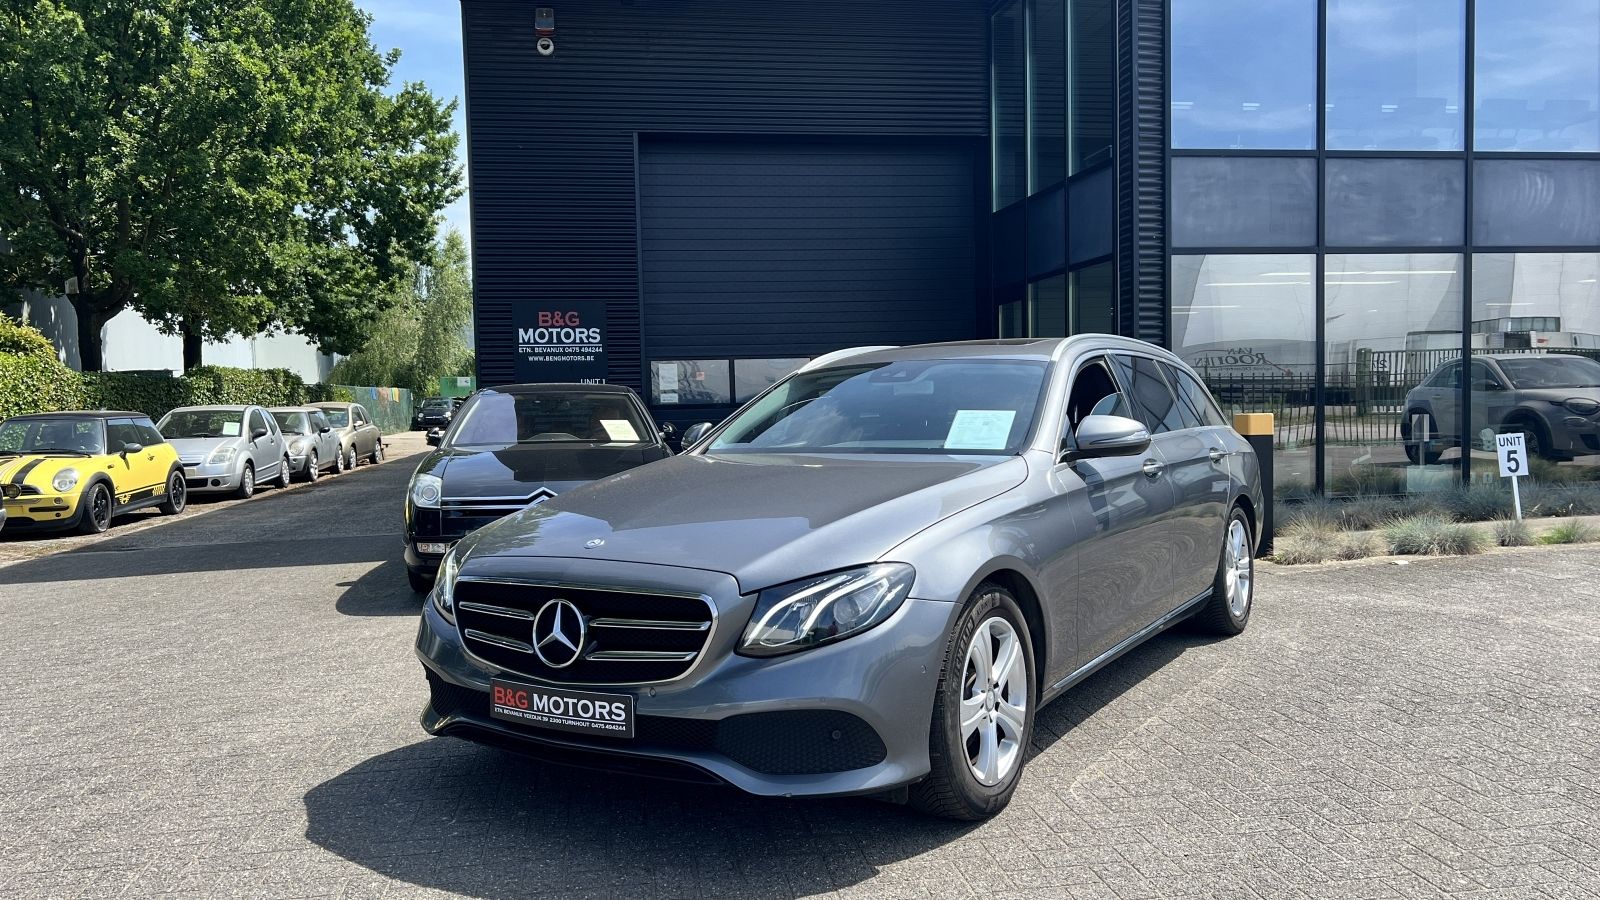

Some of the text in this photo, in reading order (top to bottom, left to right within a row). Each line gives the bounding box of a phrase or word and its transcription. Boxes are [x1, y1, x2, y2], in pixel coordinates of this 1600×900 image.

[538, 311, 580, 327] B&G
[518, 327, 601, 343] MOTORS
[1498, 436, 1522, 447] UNIT
[1507, 449, 1520, 473] 5
[494, 686, 626, 721] B&G MOTORS
[562, 719, 590, 727] TURNHOUT
